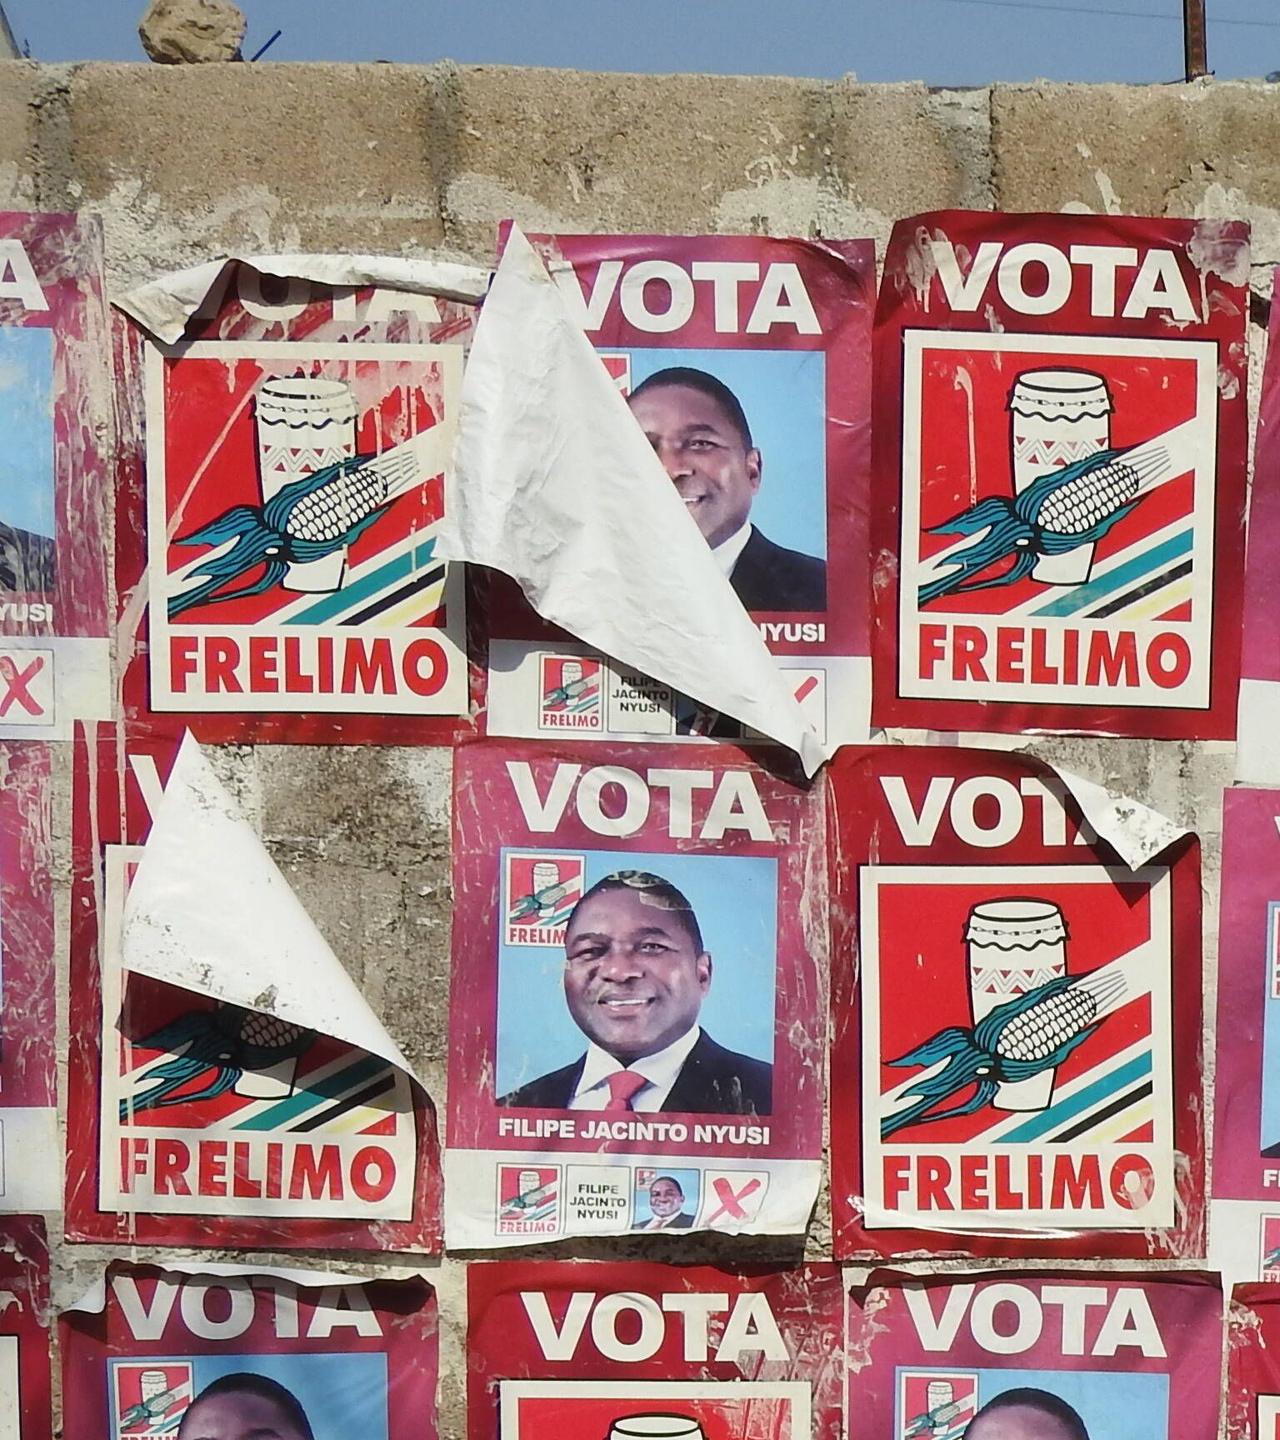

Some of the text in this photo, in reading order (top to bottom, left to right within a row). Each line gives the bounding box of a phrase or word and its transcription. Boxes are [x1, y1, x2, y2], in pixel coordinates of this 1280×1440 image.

[929, 242, 1200, 323] VOTA
[169, 636, 449, 697] FRELIMO
[919, 624, 1191, 690] FRELIMO
[542, 712, 600, 727] FRELIMO
[505, 760, 775, 842] VOTA
[498, 1118, 771, 1145] FILIPE JACINTO NYUSI
[119, 1136, 397, 1202] FRELIMO
[578, 1184, 619, 1195] FILIPE
[882, 1154, 1155, 1211] FRELIMO
[500, 1220, 556, 1233] FRELIMO
[569, 1196, 627, 1208] JACINTO
[577, 1208, 618, 1220] NYUSI
[107, 1275, 384, 1342] VOTA
[520, 1291, 791, 1363] VOTA
[901, 1285, 1168, 1359] VOTA
